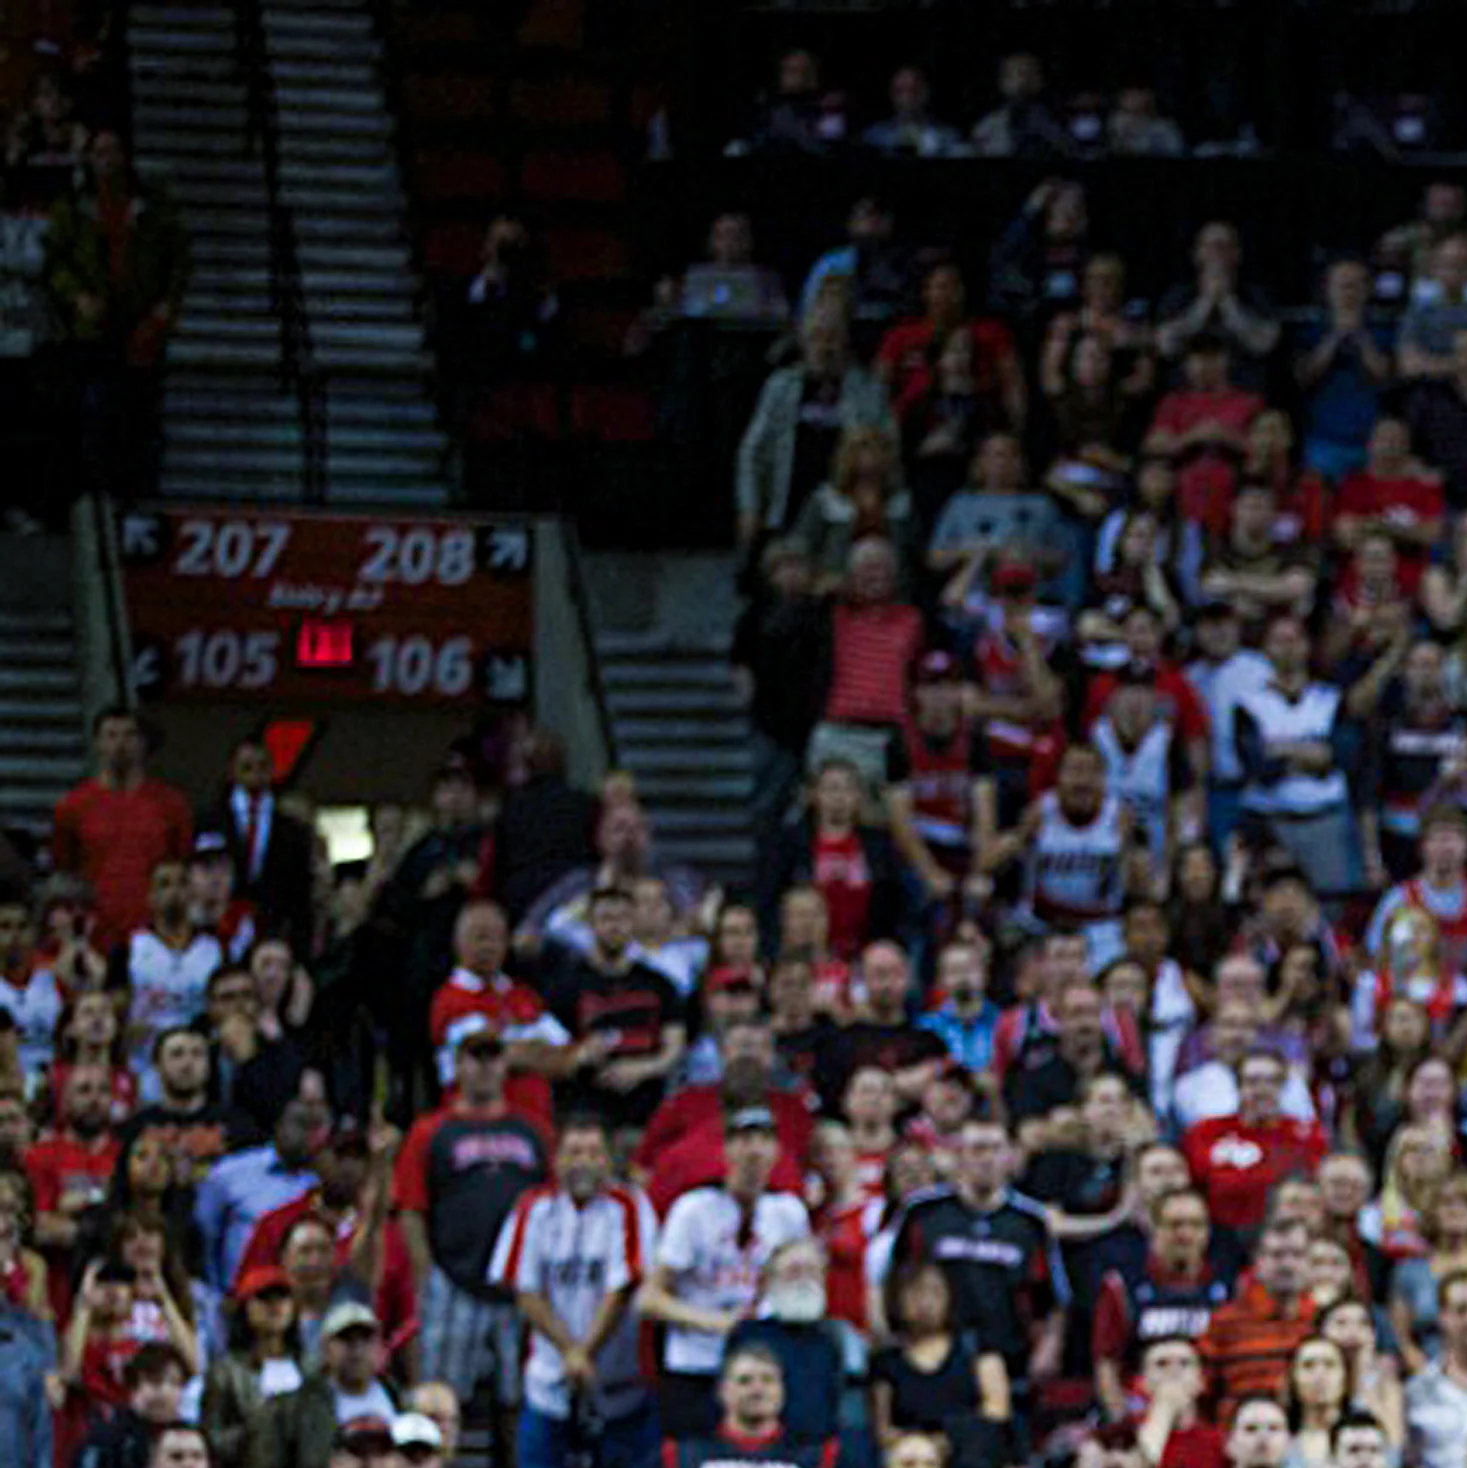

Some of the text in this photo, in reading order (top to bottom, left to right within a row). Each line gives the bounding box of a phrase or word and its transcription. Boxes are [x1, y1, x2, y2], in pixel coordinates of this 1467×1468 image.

[174, 519, 476, 586] 207 208
[175, 630, 279, 688] 105
[368, 636, 473, 695] 106
